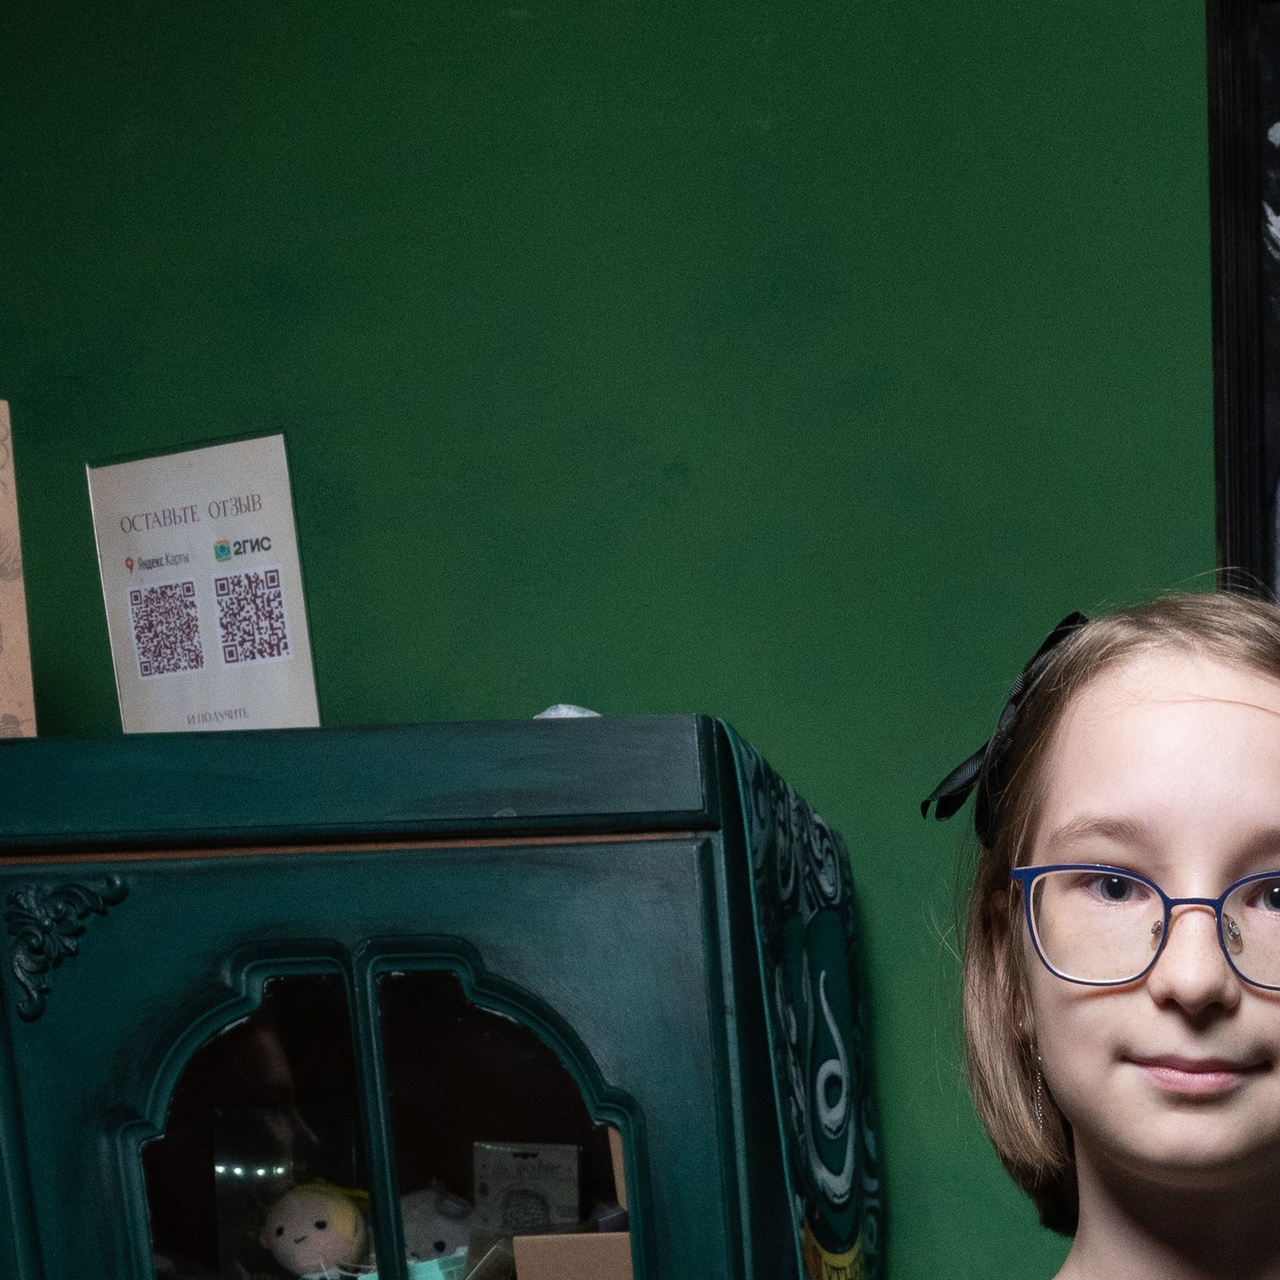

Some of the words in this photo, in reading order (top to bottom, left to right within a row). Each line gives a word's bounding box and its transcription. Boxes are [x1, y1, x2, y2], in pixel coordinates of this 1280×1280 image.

[120, 504, 200, 533] ОСТАВЬТЕ
[208, 493, 262, 519] ОТЗЫВ
[233, 536, 272, 555] 2ГИС
[137, 556, 165, 571] Яндекс
[165, 552, 190, 567] Карты
